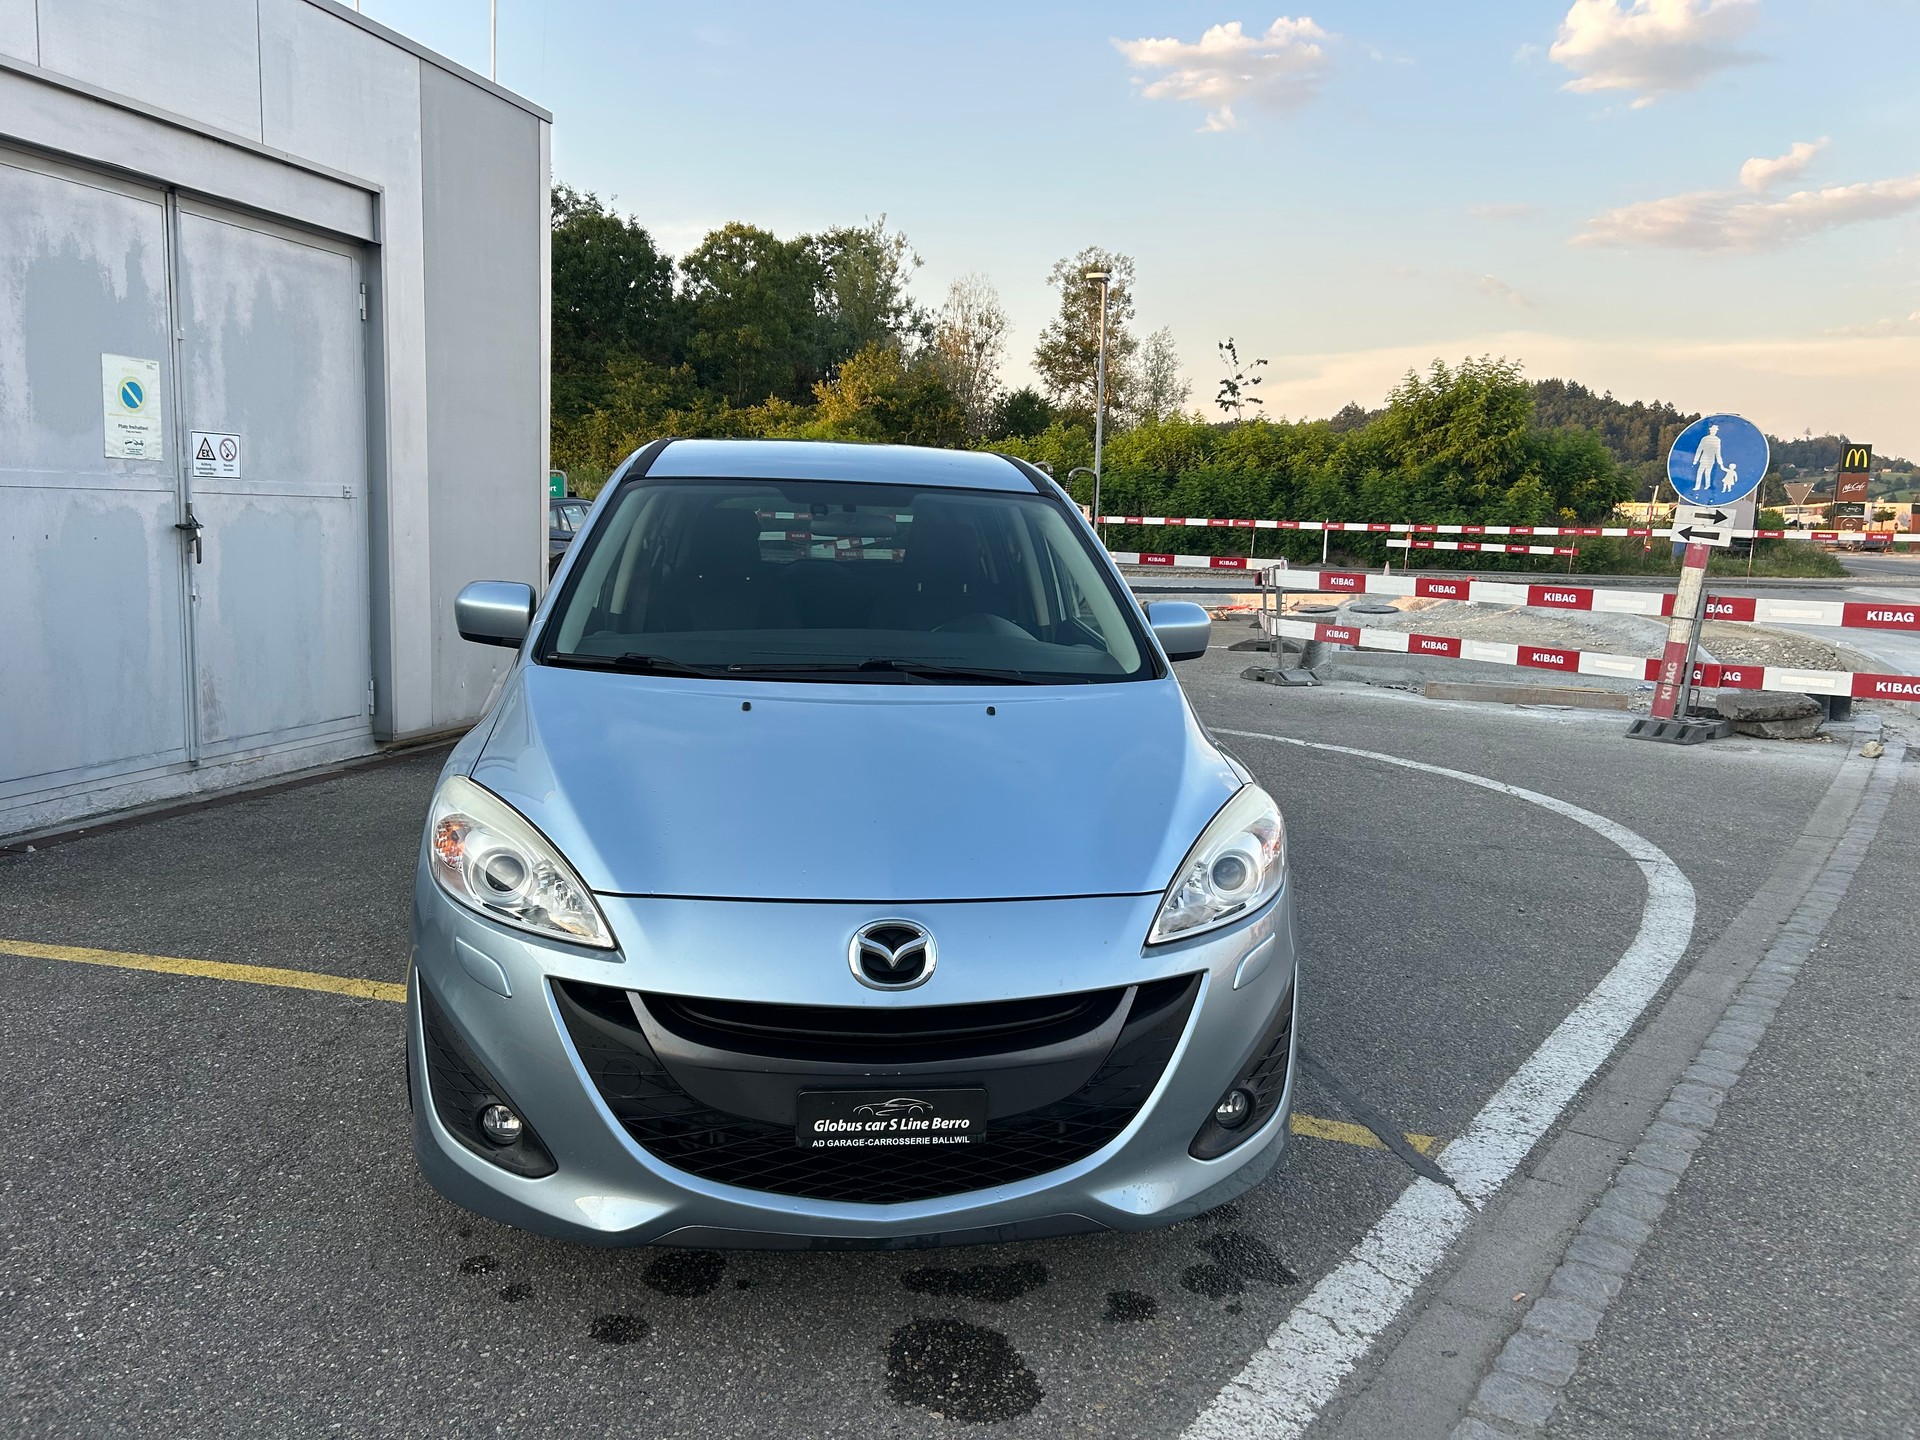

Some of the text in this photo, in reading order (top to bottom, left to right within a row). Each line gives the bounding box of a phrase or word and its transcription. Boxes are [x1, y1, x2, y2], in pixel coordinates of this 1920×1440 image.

[201, 449, 211, 458] EX
[1330, 577, 1355, 587] KIBAG
[1428, 584, 1457, 594] KIBAG
[1543, 592, 1577, 603] KIBAG
[1706, 603, 1734, 614] BAG
[1866, 610, 1915, 623] KIBAG
[1326, 629, 1349, 639] KIBAG
[1421, 640, 1448, 651] KIBAG
[1532, 652, 1564, 664] KIBAG
[1661, 662, 1678, 700] KIBAG
[1875, 681, 1920, 695] KIBAG
[813, 1117, 970, 1132] Globus car S Line Berro
[812, 1136, 970, 1148] AD GARAGE-CARROSSERIE BALLWIL
